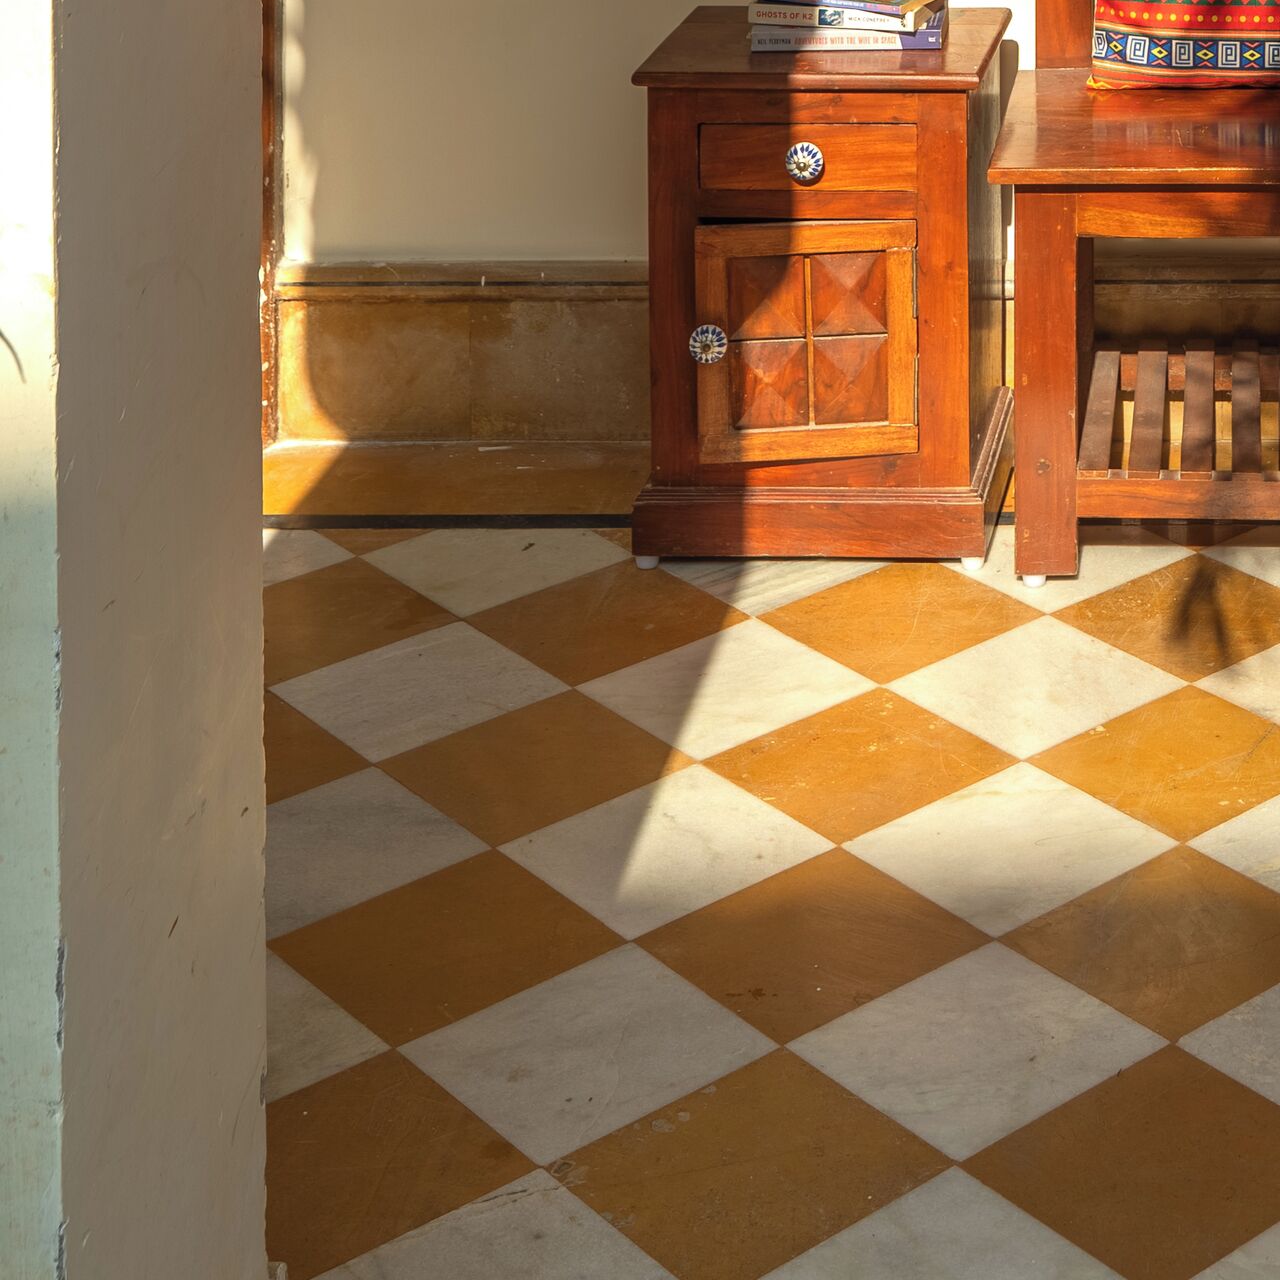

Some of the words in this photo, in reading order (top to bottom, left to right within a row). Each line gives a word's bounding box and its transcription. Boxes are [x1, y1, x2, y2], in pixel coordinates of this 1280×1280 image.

[756, 10, 787, 19] GHOSTS
[789, 12, 801, 20] OF
[802, 12, 814, 20] K2
